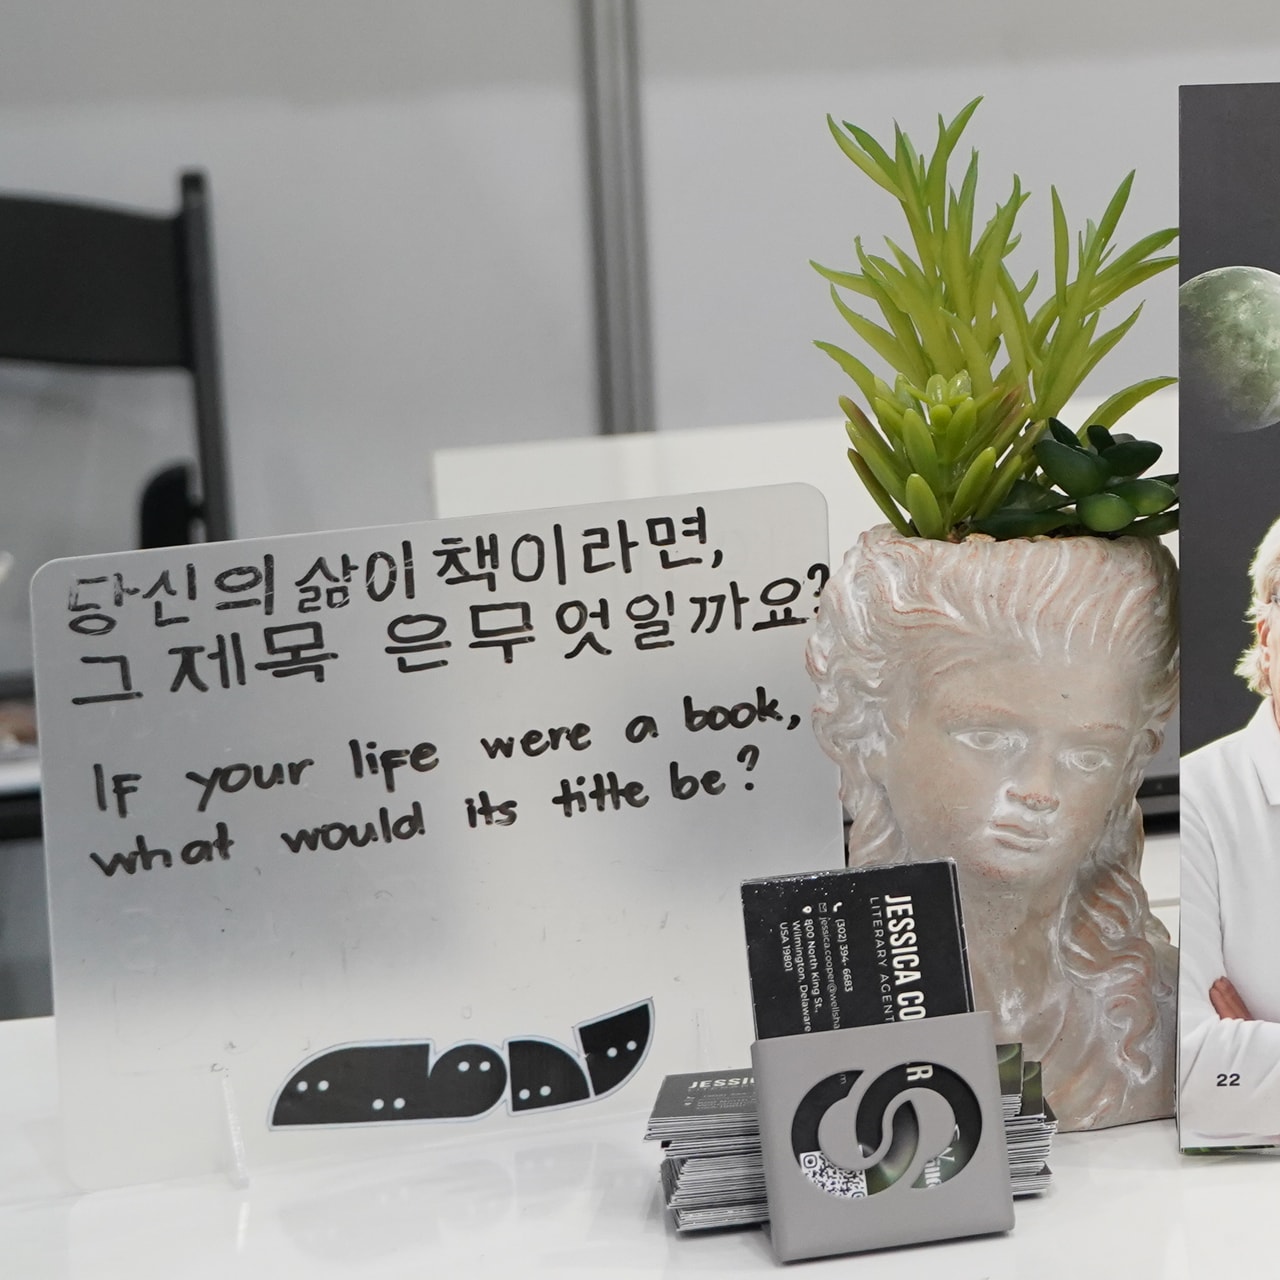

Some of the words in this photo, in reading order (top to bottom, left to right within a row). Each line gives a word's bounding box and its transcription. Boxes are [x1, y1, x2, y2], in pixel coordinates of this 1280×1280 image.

[67, 553, 275, 636] 당신의
[294, 539, 416, 614] 삶이
[432, 505, 724, 592] 책이라면,
[185, 755, 316, 813] your
[351, 739, 441, 796] life
[480, 722, 592, 760] were
[625, 714, 660, 744] a
[682, 685, 802, 733] book,
[88, 822, 236, 879] what
[279, 800, 427, 857] would
[464, 790, 518, 829] its
[779, 921, 791, 945] USA
[807, 939, 819, 971] North
[834, 918, 848, 944] (302)
[842, 967, 854, 993] 6683
[883, 893, 923, 987] JESSICA
[782, 945, 794, 972] 19801
[817, 915, 841, 1030] jessica.cooper@wellsha
[869, 896, 889, 968] LITERARY
[879, 973, 896, 1023] AGENT
[810, 971, 821, 996] King
[896, 990, 927, 1022] CO
[799, 984, 812, 1033] Delaware
[688, 1076, 755, 1090] JESSI
[1215, 1072, 1241, 1088] 22
